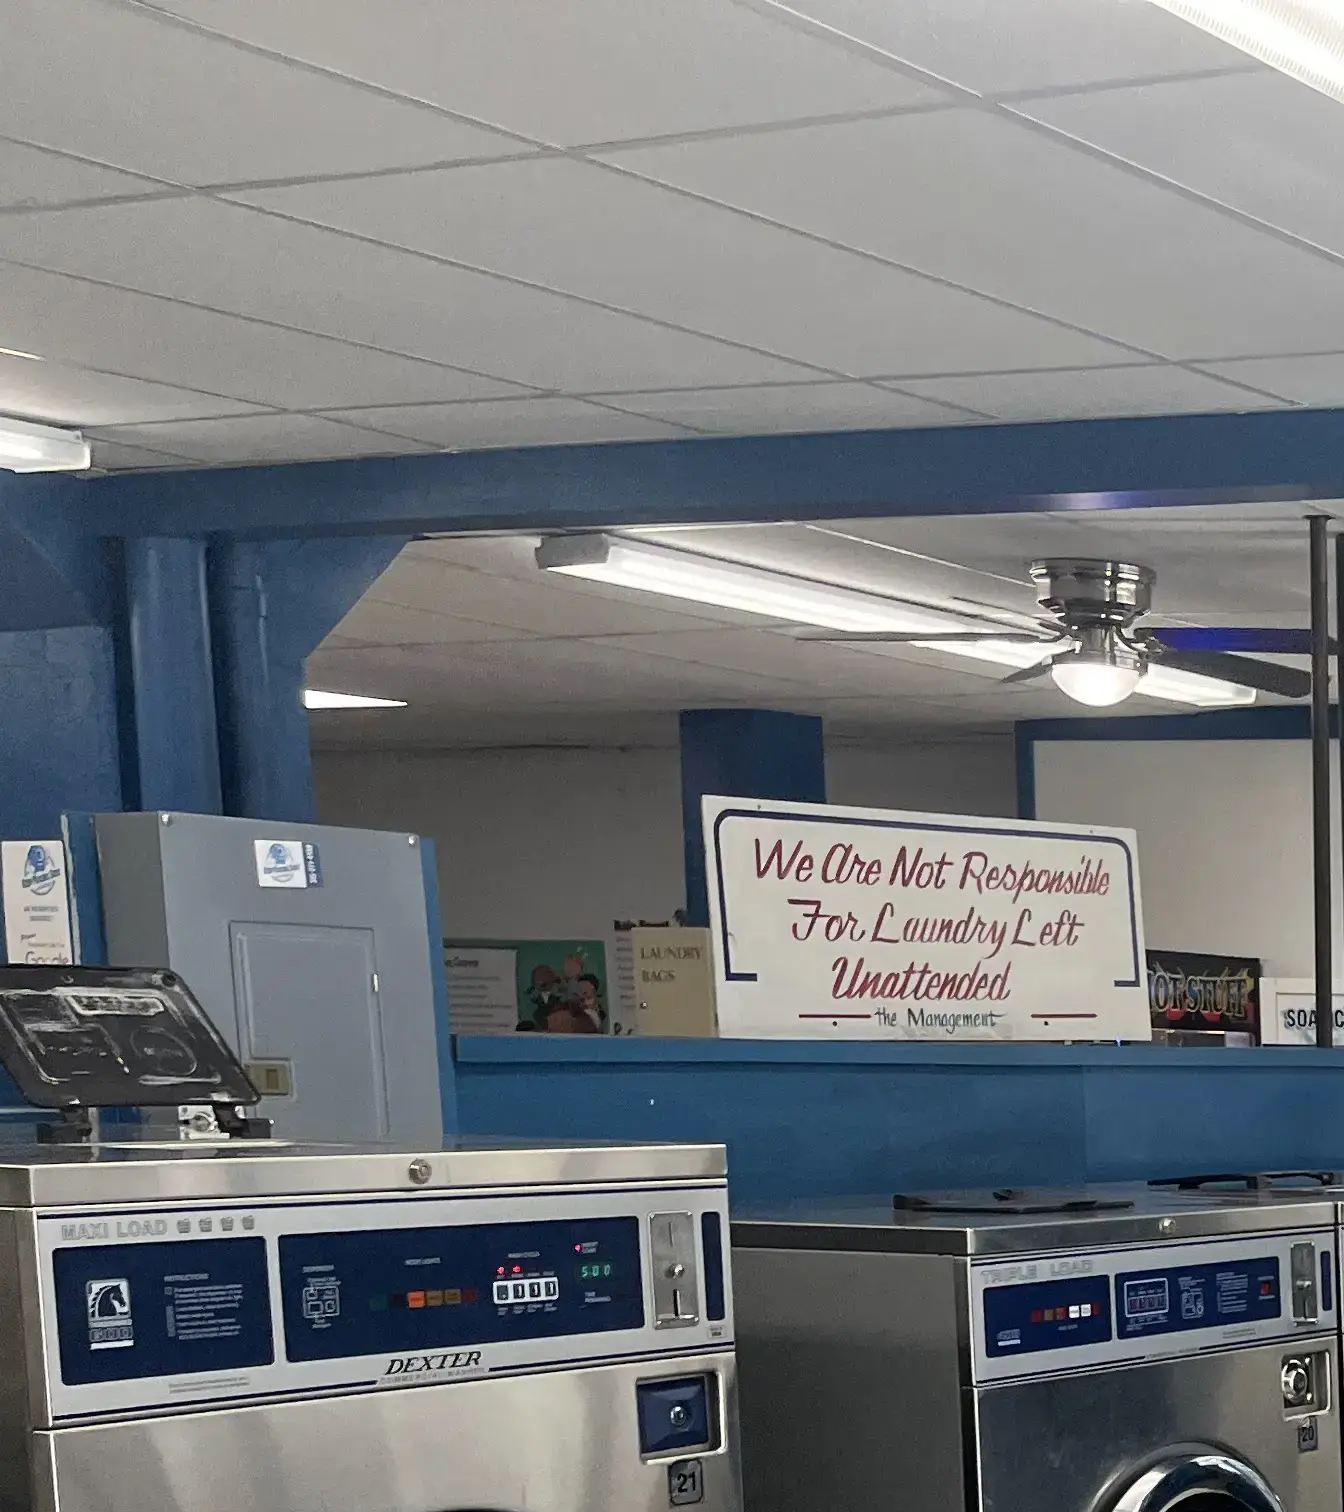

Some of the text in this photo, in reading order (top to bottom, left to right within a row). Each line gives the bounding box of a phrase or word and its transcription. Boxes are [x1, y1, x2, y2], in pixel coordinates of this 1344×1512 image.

[754, 838, 1110, 904] We Are Not Responsible
[788, 898, 1085, 959] For Laundry Left
[640, 945, 703, 960] LAUNDRY
[832, 957, 1011, 1001] Unattended
[874, 1007, 1008, 1034] the Management
[61, 1219, 167, 1241] MAXI LOAD
[582, 1263, 612, 1278] 500
[385, 1350, 481, 1375] DEXTER
[1302, 1425, 1315, 1442] 20
[677, 1471, 697, 1493] 21
